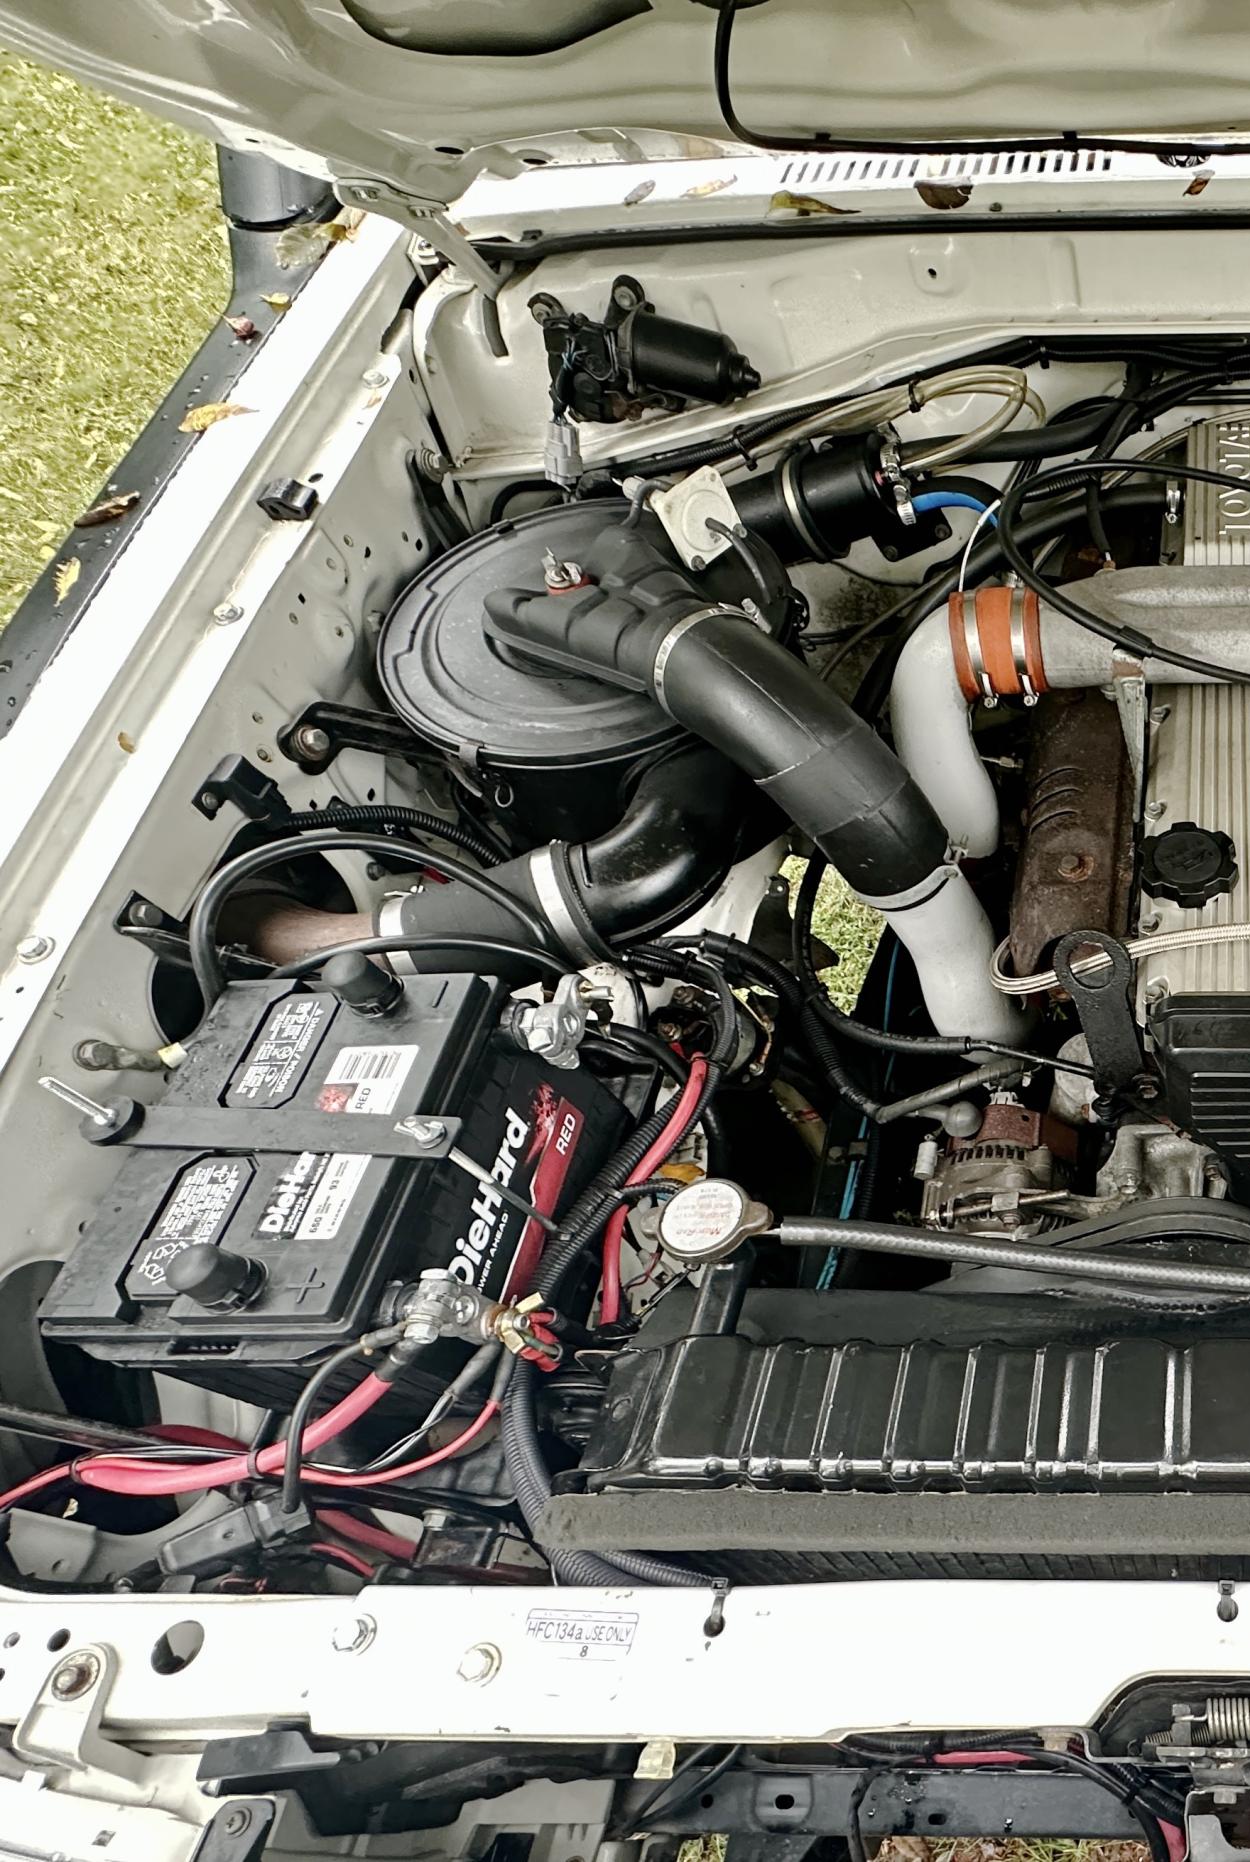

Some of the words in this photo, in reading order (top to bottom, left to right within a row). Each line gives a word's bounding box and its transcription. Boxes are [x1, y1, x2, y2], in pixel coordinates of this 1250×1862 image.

[355, 1087, 371, 1110] RED
[555, 1113, 576, 1155] RED
[447, 1107, 529, 1286] DieHard
[490, 1211, 509, 1258] AHEAD
[526, 1621, 583, 1641] HFC134a
[585, 1625, 606, 1641] USE
[605, 1626, 632, 1642] ONLY
[580, 1645, 589, 1657] 8
